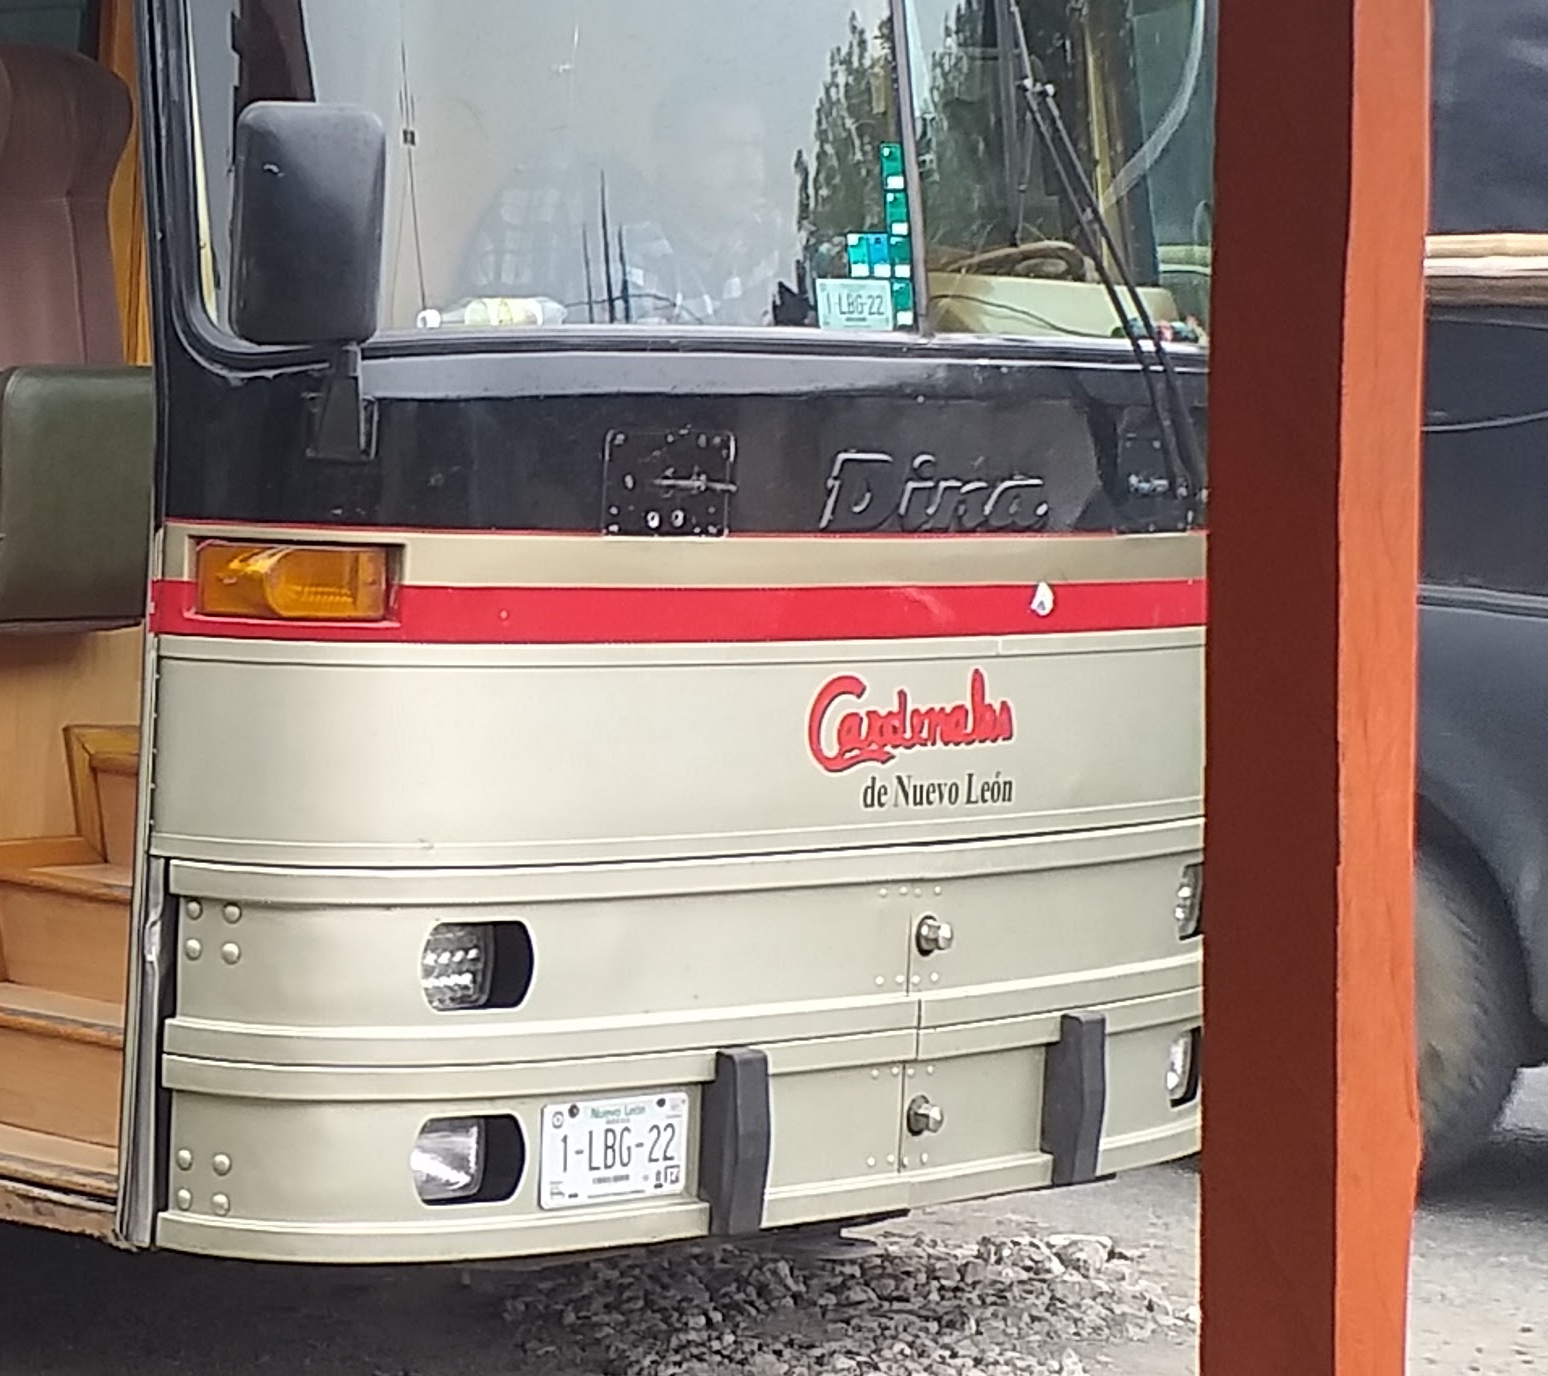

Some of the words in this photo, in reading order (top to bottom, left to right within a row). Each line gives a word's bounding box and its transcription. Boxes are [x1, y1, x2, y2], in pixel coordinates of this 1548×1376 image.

[818, 451, 1050, 530] Dina
[863, 776, 888, 808] de
[893, 775, 960, 807] Nuevo
[965, 771, 1013, 805] León
[590, 1107, 621, 1119] Nuevo
[561, 1123, 676, 1173] 1-LBG-22
